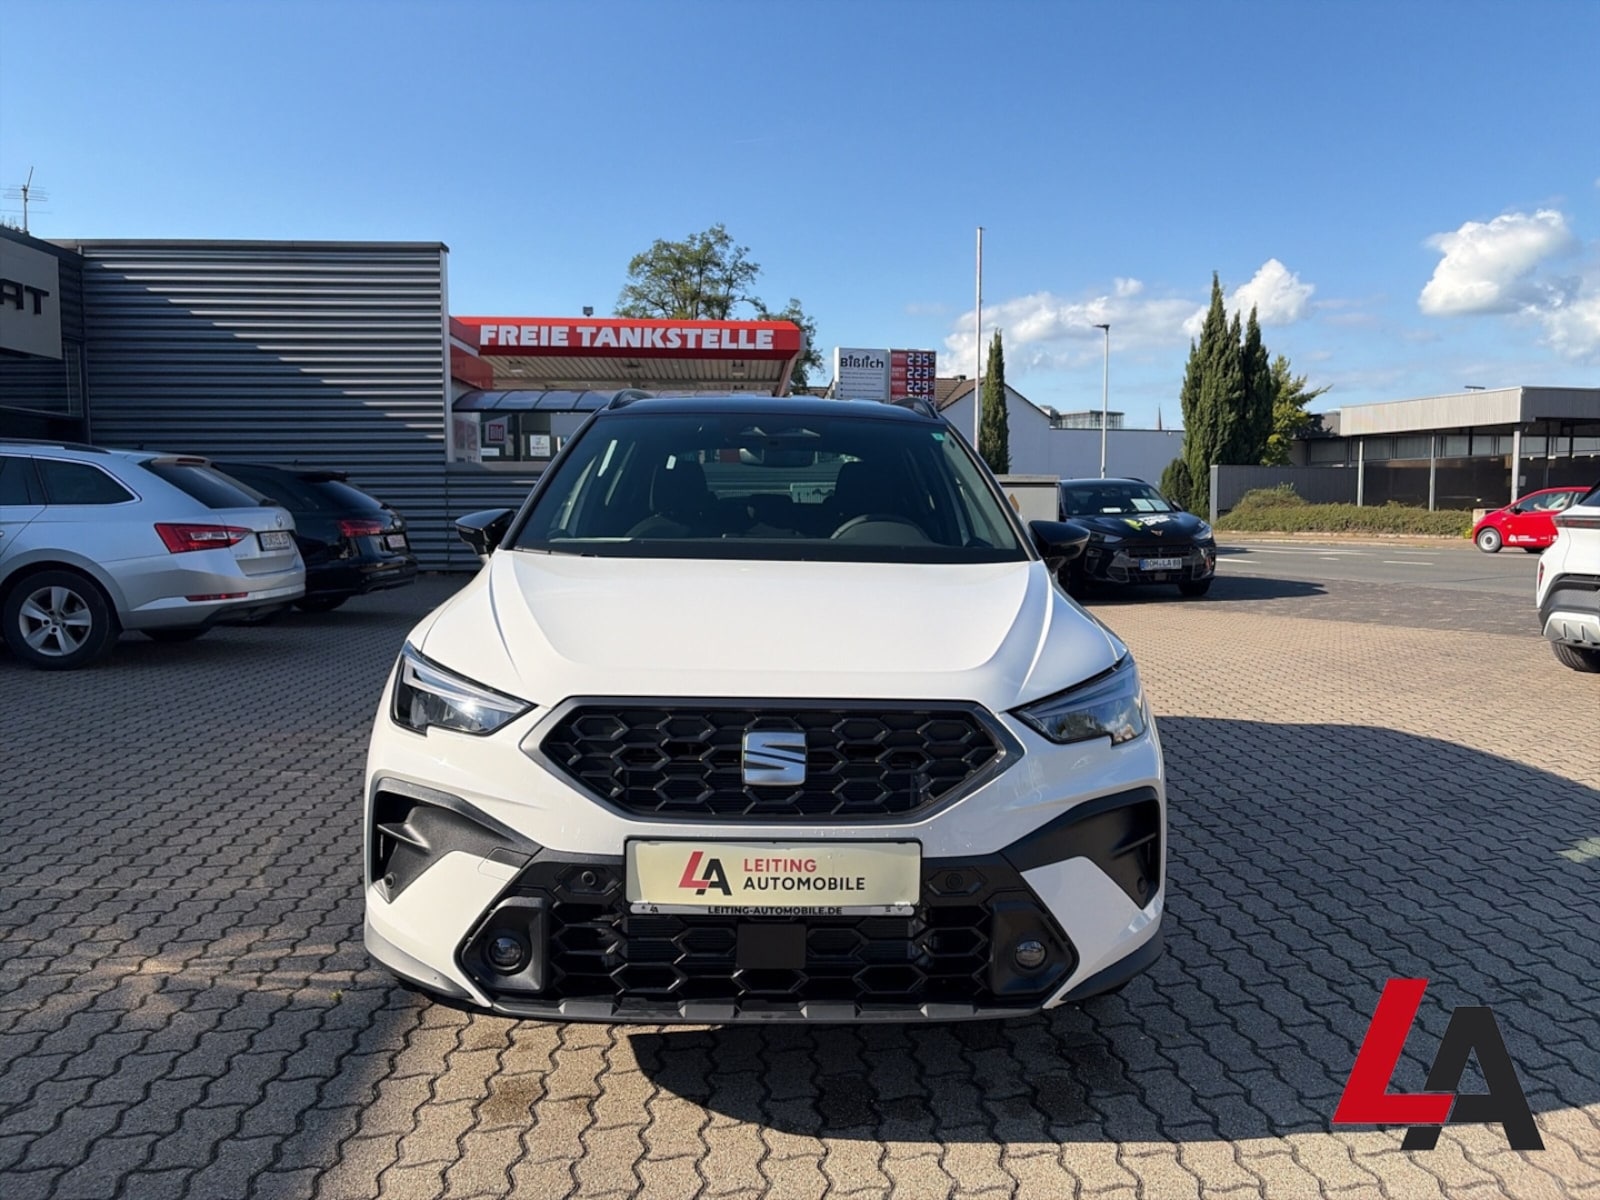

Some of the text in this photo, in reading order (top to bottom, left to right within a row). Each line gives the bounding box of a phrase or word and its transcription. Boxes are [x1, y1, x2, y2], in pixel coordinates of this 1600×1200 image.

[480, 324, 774, 350] FREIE TANKSTELLE
[840, 355, 884, 368] Bißlich
[743, 858, 817, 873] LEITING
[678, 851, 732, 896] LA
[743, 876, 866, 891] AUTOMOBILE
[707, 905, 842, 915] LEITING-AUTOMOBILE.DE
